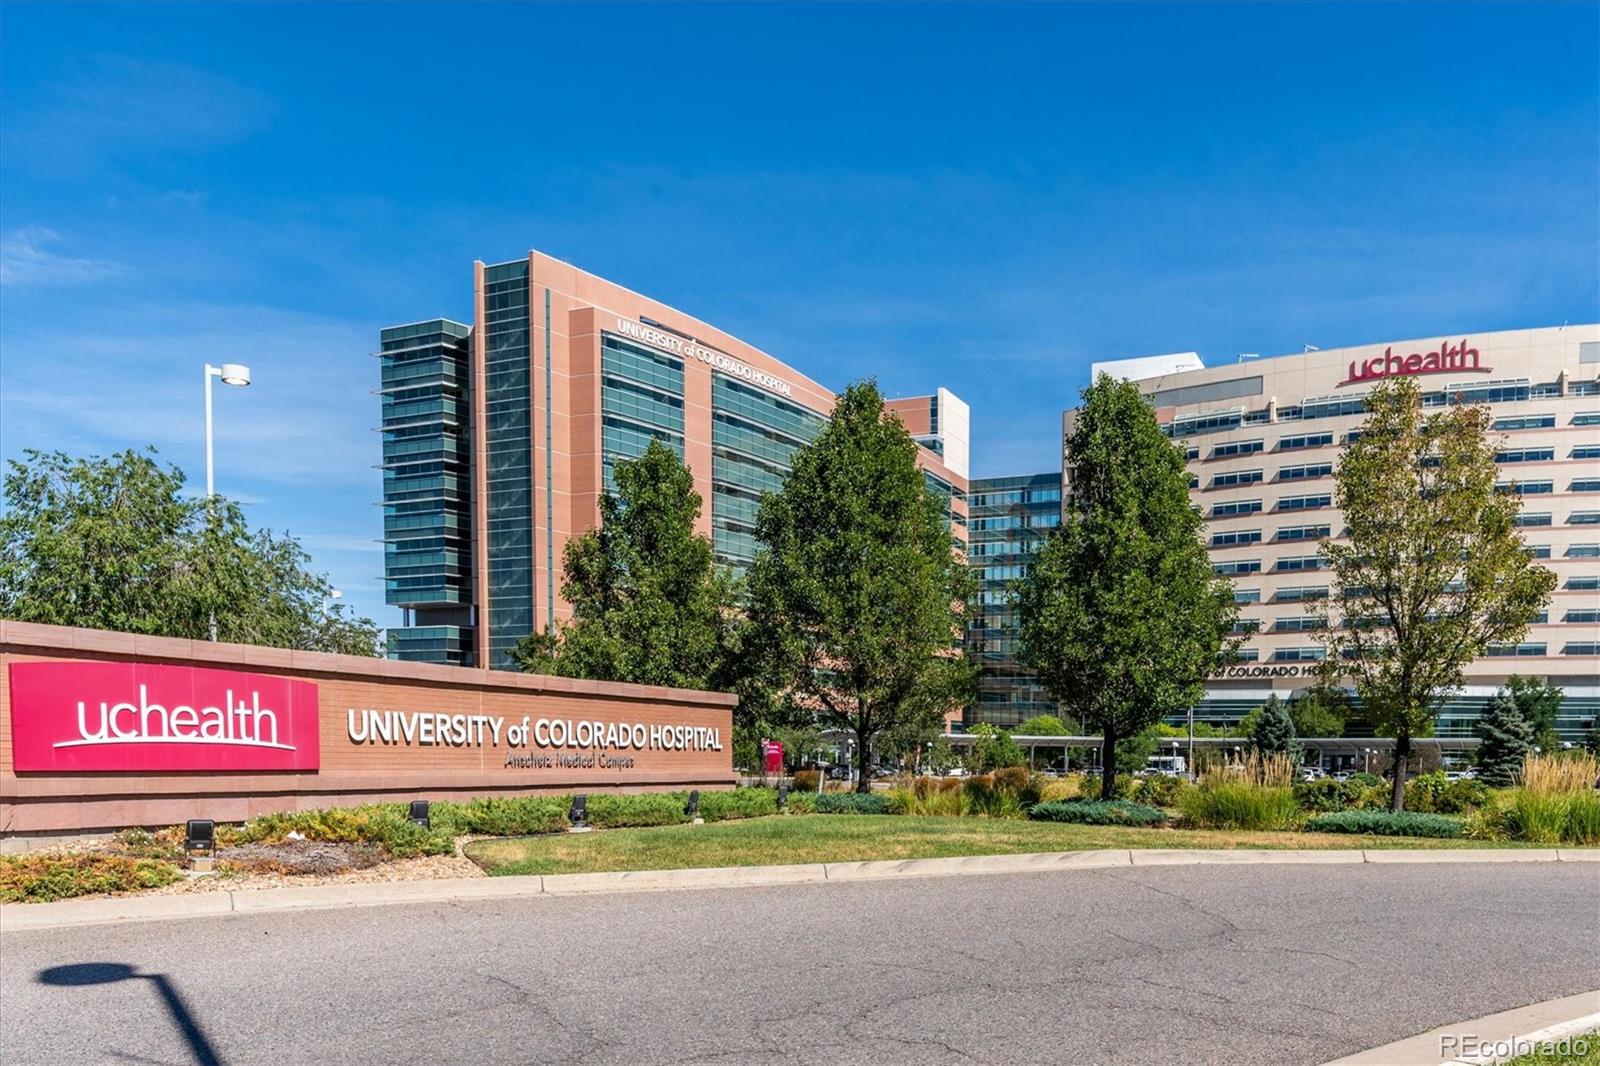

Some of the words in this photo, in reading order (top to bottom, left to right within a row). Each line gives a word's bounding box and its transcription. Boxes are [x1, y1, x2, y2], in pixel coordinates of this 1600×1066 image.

[617, 318, 684, 354] UNIVERSITY
[683, 344, 697, 359] of
[697, 349, 752, 379] COLORADO
[752, 367, 792, 398] HOSPITAL
[1348, 339, 1480, 381] uchealth
[1228, 665, 1299, 678] COLORADO
[77, 684, 278, 743] uchealth
[347, 709, 504, 747] UNIVERSITY
[507, 716, 530, 748] of
[534, 718, 647, 749] COLORADO
[650, 724, 723, 752] HOSPITAL
[556, 750, 596, 769] Medical
